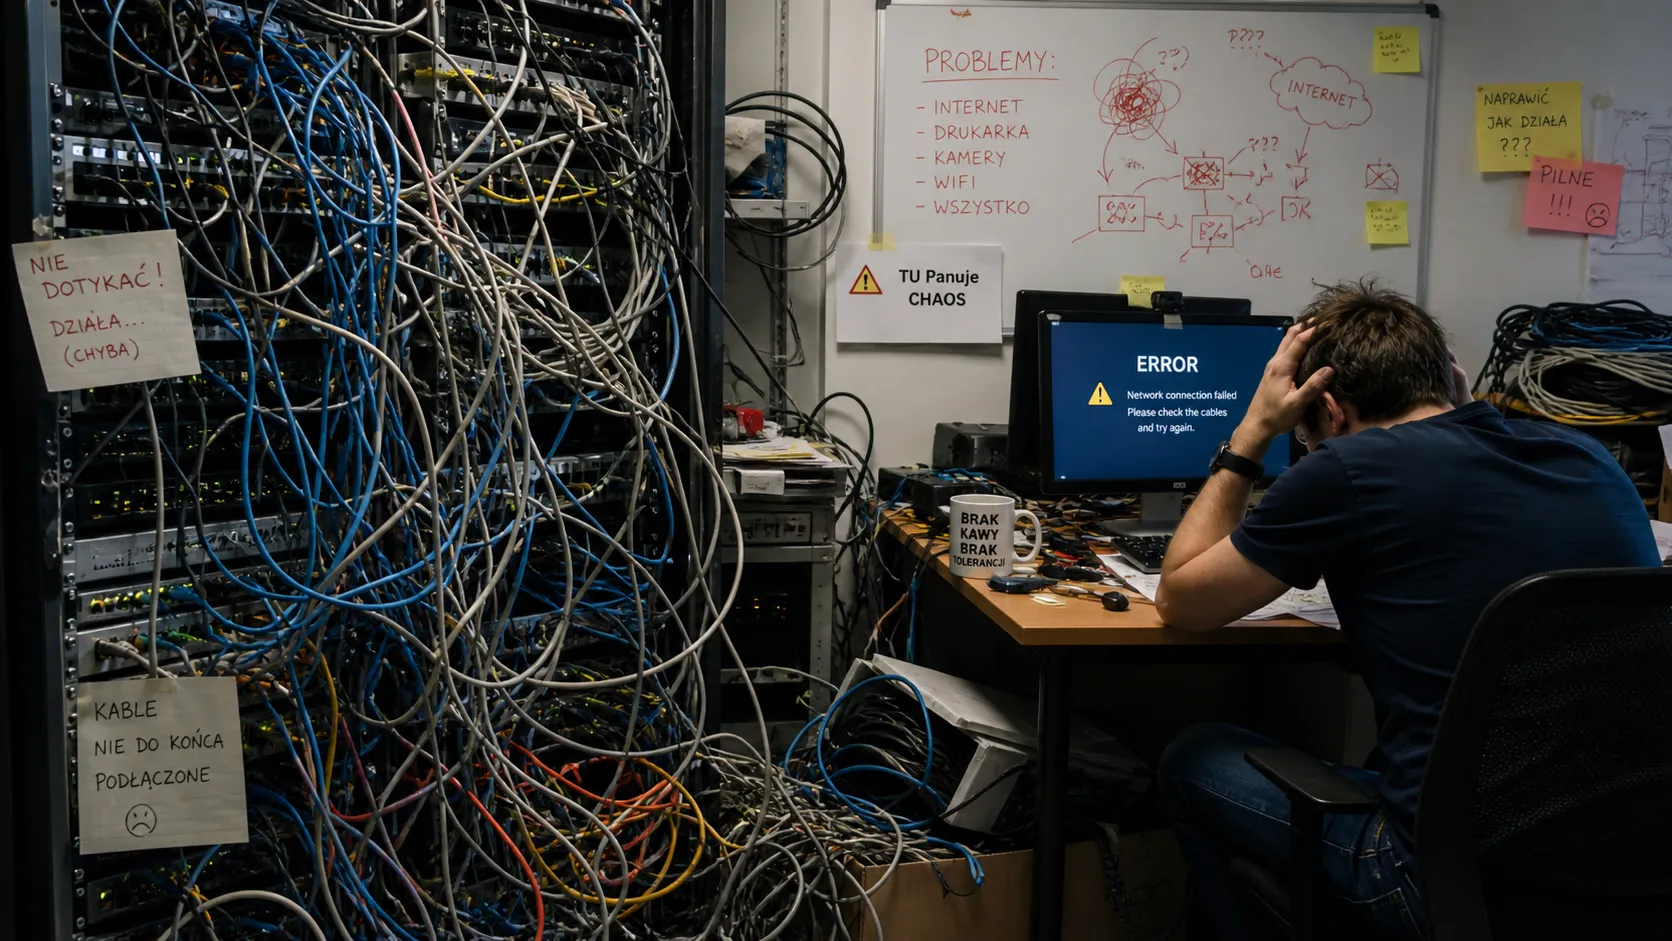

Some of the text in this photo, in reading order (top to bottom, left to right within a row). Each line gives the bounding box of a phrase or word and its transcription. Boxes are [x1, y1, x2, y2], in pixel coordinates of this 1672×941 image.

[924, 48, 1056, 73] PROBLEMY:
[1287, 79, 1358, 110] INTERNET
[934, 99, 1024, 115] INTERNET
[1487, 114, 1568, 130] JAK DZIAŁA
[934, 124, 1030, 141] DRUKARKA
[1500, 137, 1532, 158] ???
[934, 150, 1006, 168] KAMERY
[934, 174, 976, 190] WIFI
[1540, 164, 1595, 188] PILNE
[933, 199, 1031, 216] WSZYSTKO
[1548, 193, 1574, 218] !!!
[29, 253, 69, 275] NIE
[898, 269, 980, 287] TU Panuje
[908, 292, 967, 307] CHAOS
[49, 313, 145, 337] DZIAŁA...
[64, 337, 140, 368] (CHYBA)
[1136, 355, 1199, 373] ERROR
[1127, 390, 1164, 400] Network
[1165, 390, 1212, 400] connection
[1127, 407, 1228, 417] Please check the cables
[1137, 423, 1195, 435] and try again.
[961, 512, 999, 525] BRAK
[960, 527, 999, 540] KAWY
[960, 542, 998, 556] BRAK
[953, 555, 1006, 567] TOLERANCJI
[94, 700, 158, 722] KABLE
[94, 728, 224, 756] NIE DO KOŃCA
[95, 767, 211, 791] PODŁĄCZONE
